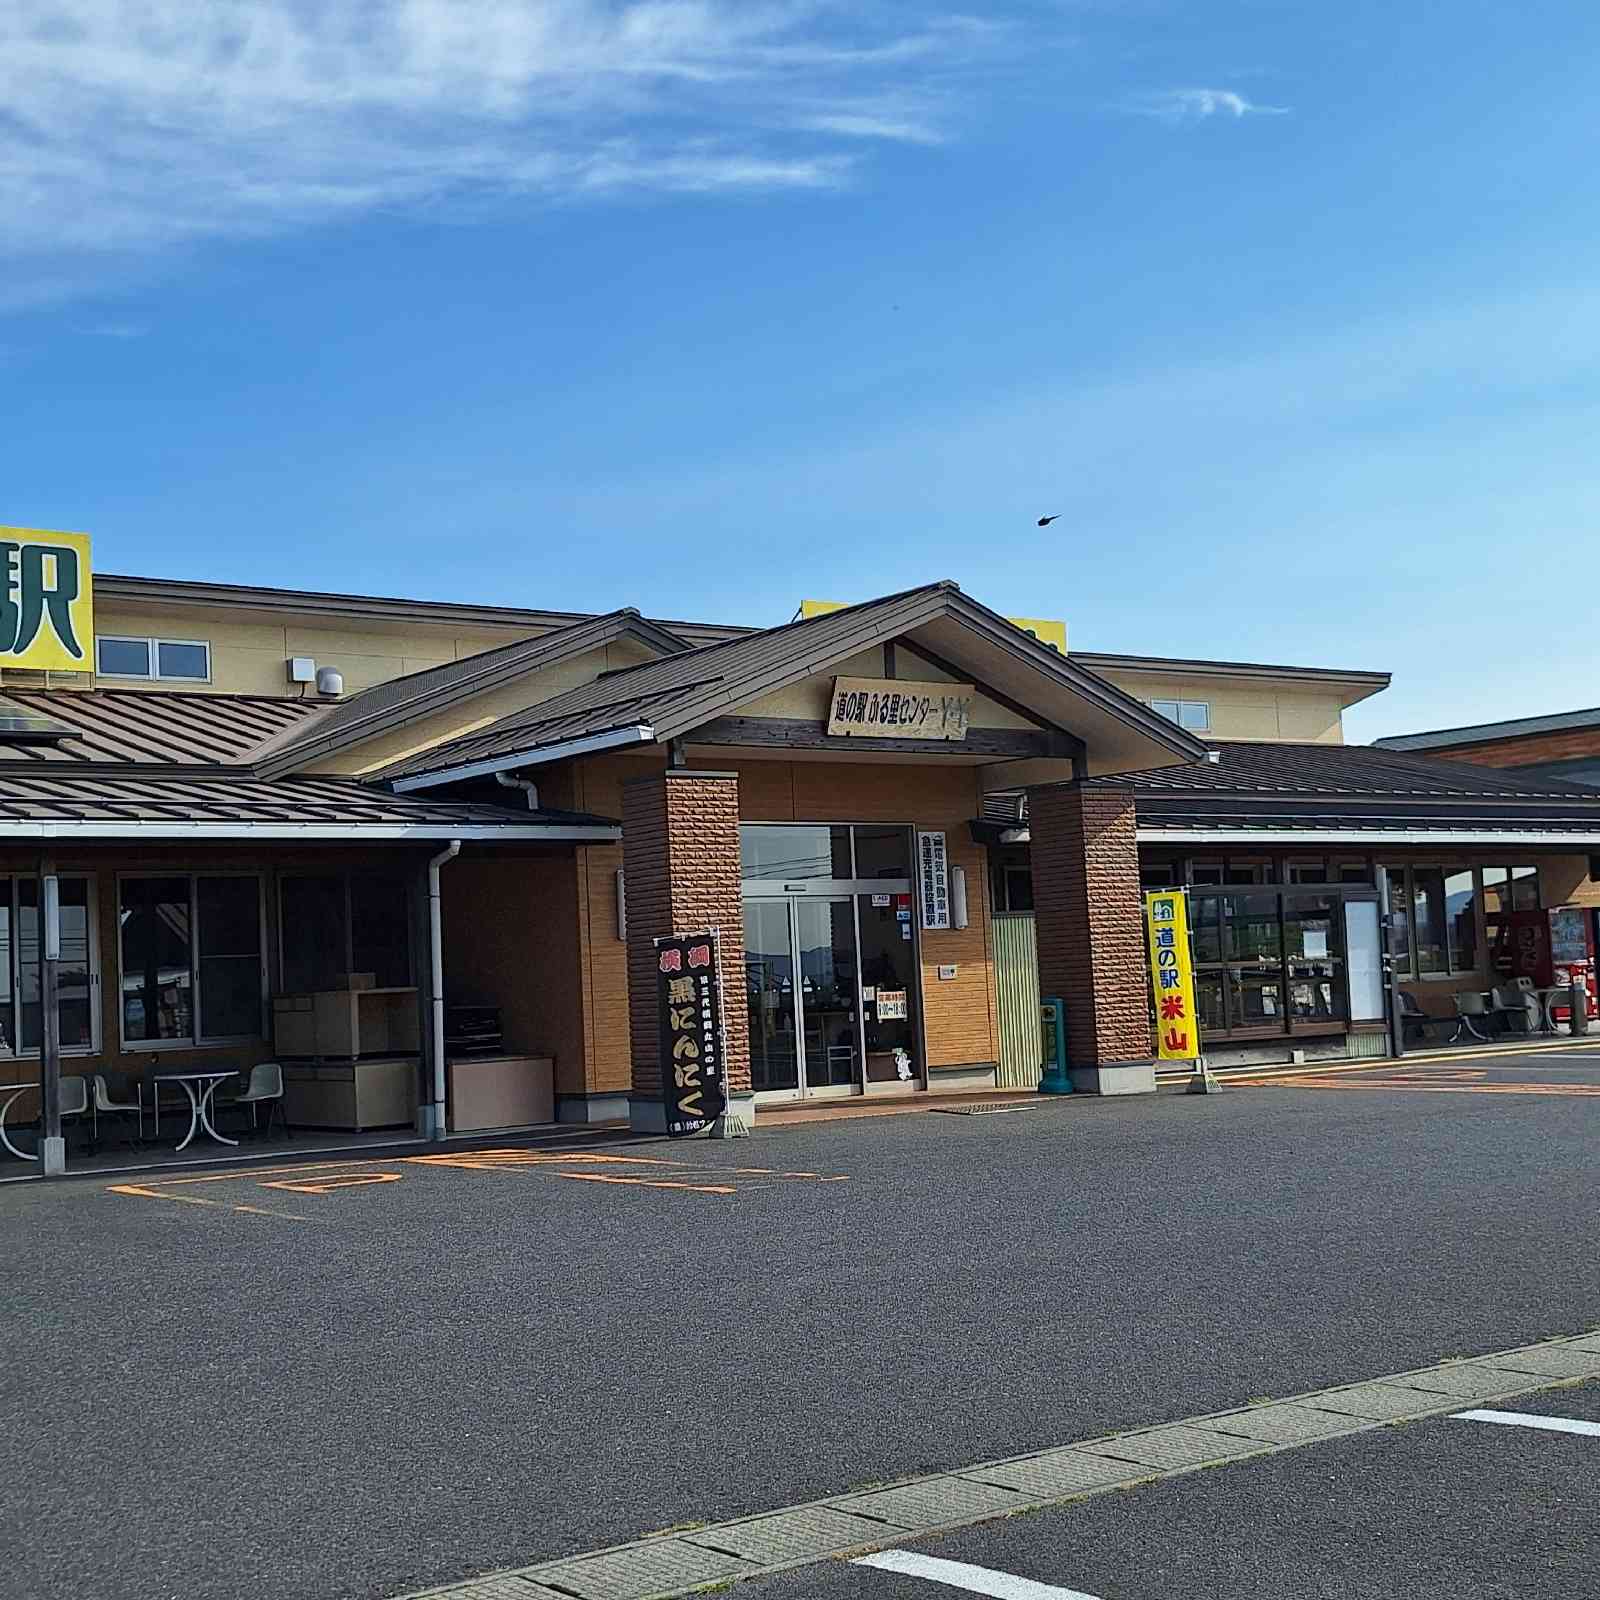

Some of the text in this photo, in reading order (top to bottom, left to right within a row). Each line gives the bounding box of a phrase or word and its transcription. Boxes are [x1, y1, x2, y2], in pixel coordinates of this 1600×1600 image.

[835, 691, 868, 723] 道の駅
[869, 693, 938, 725] ふる里センター
[660, 945, 709, 972] 横綱
[1155, 928, 1188, 1051] 道の駅 米山
[668, 975, 704, 1116] 黒にんにく
